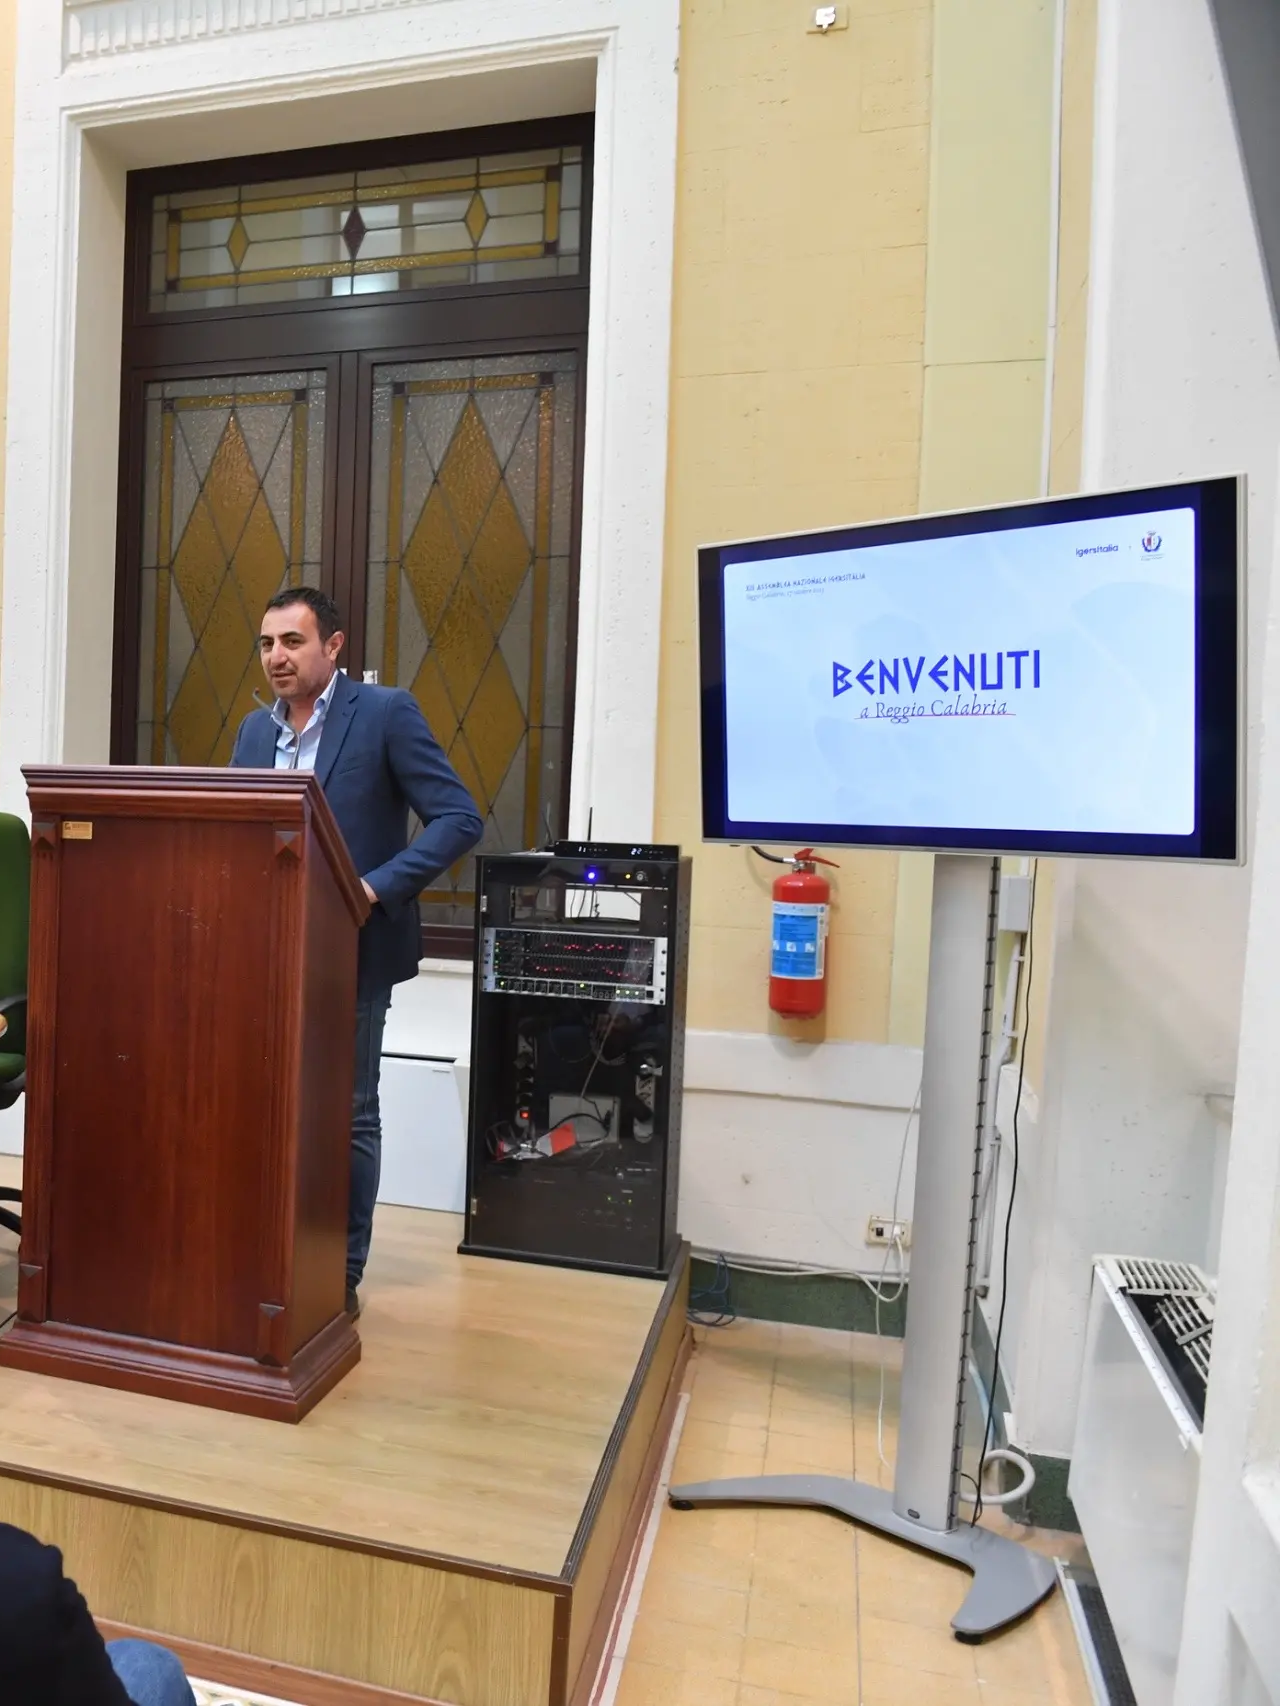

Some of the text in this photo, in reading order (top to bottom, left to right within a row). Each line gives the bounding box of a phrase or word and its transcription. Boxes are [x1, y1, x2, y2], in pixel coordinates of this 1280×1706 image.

[833, 650, 1040, 698] BENVENUTI
[859, 693, 1008, 724] a Reggio Calabria
